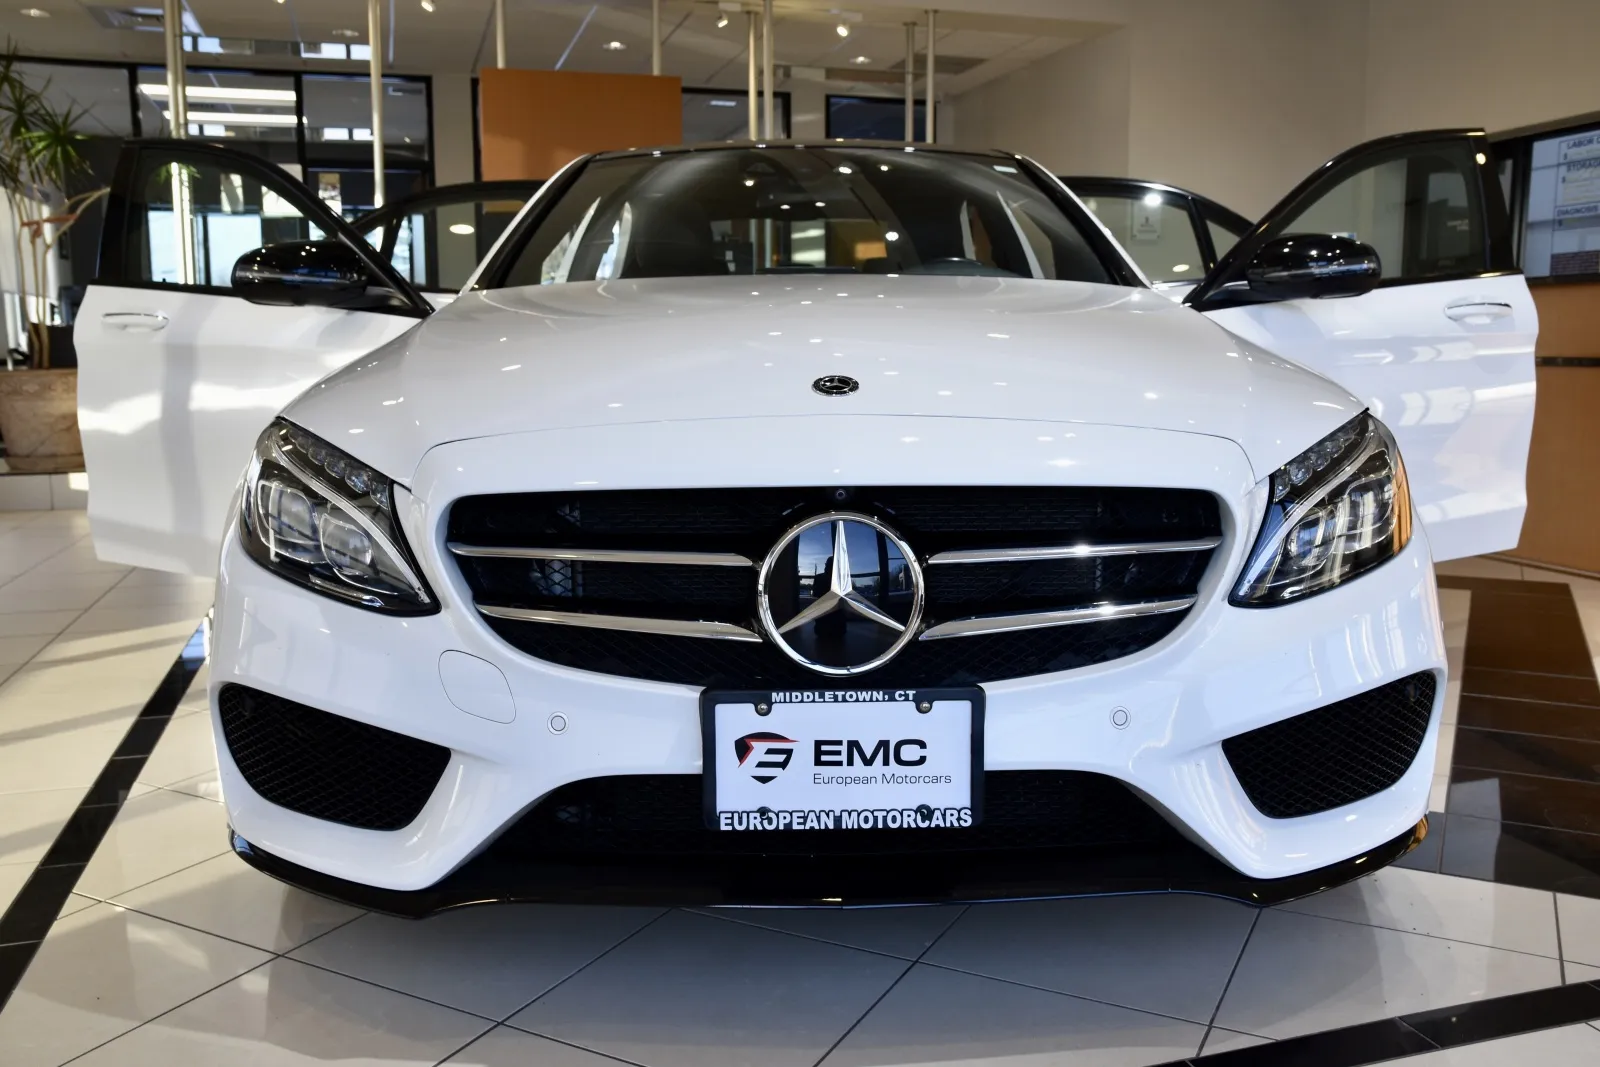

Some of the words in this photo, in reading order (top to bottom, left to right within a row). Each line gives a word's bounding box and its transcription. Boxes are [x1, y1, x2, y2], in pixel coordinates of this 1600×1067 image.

[771, 691, 889, 703] MIDDLETOWN,
[894, 690, 916, 702] CT
[813, 738, 927, 767] EMC
[813, 773, 878, 787] European
[881, 772, 952, 785] Motorcars
[719, 811, 834, 831] EUROPEAN
[841, 809, 972, 829] MOTORCARS
